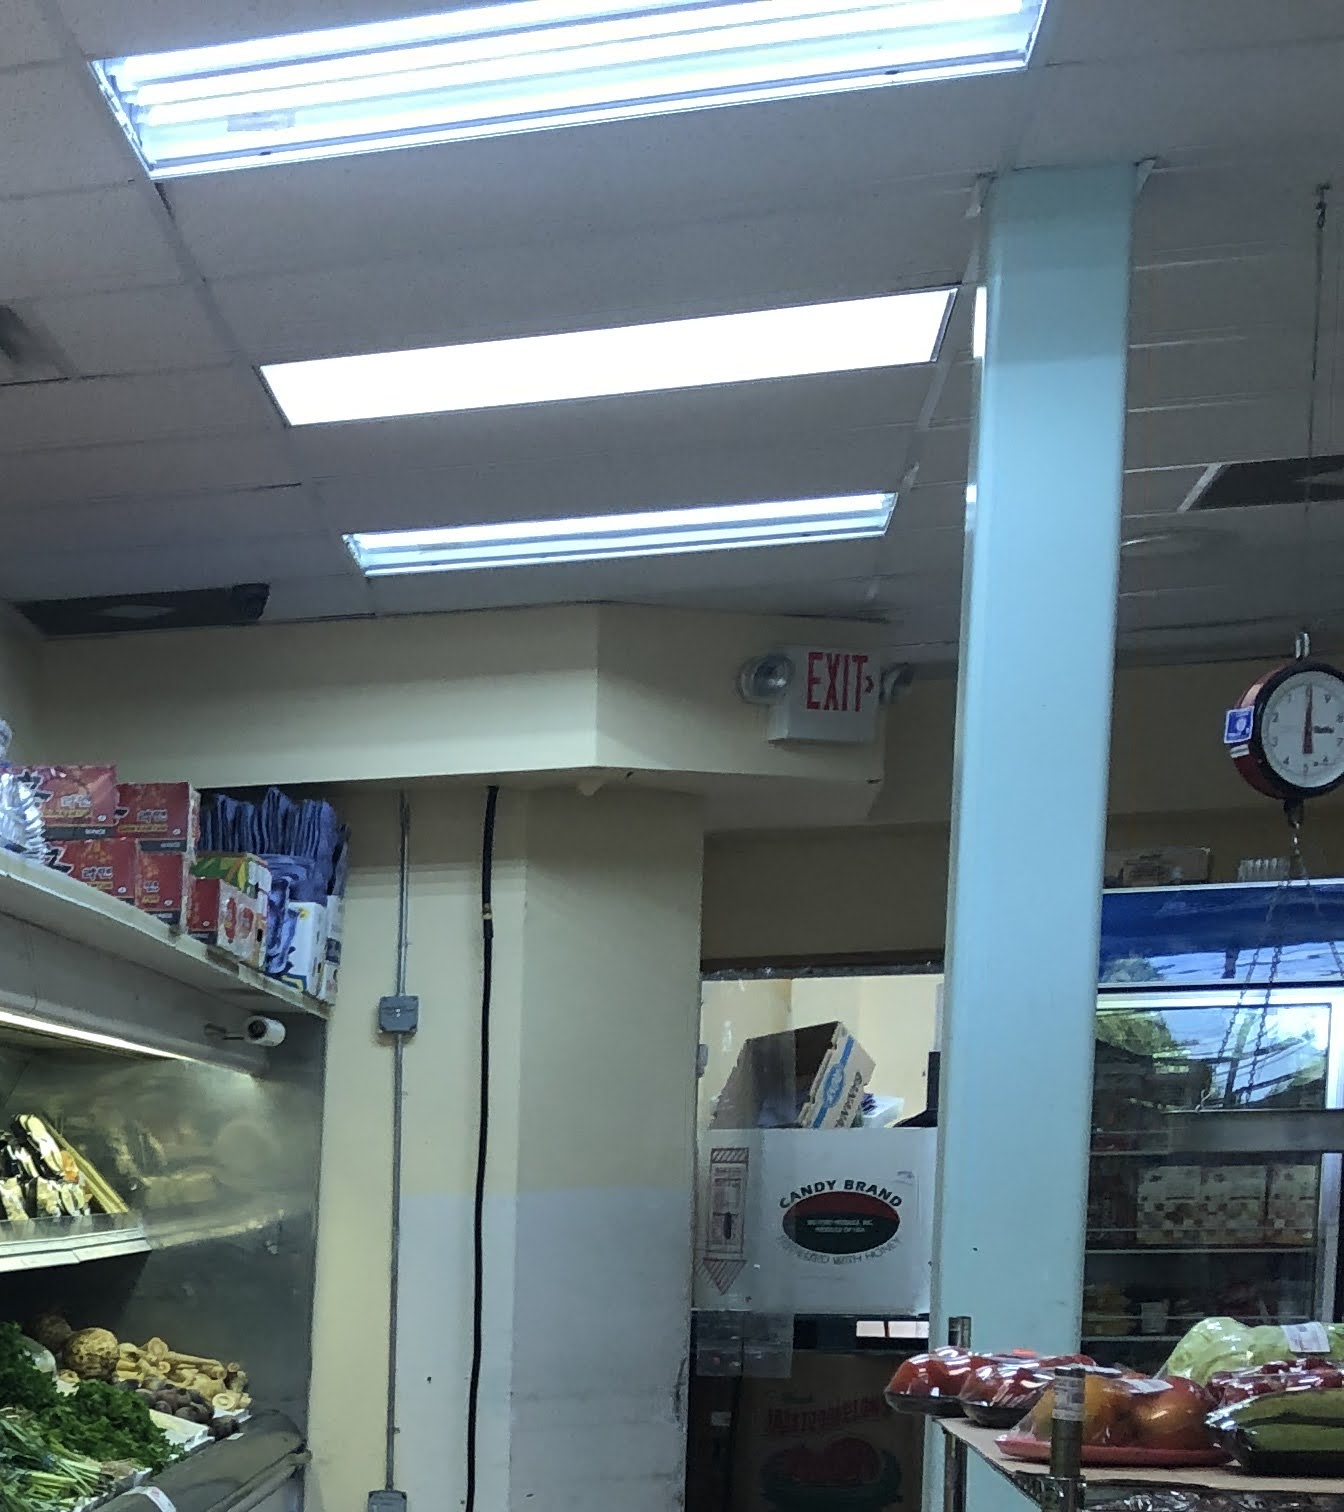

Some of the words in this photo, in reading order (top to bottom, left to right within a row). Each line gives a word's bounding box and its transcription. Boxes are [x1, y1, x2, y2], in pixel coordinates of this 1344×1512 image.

[806, 652, 869, 712] EXIT
[779, 1179, 837, 1210] CANDY
[844, 1179, 903, 1208] BRAND
